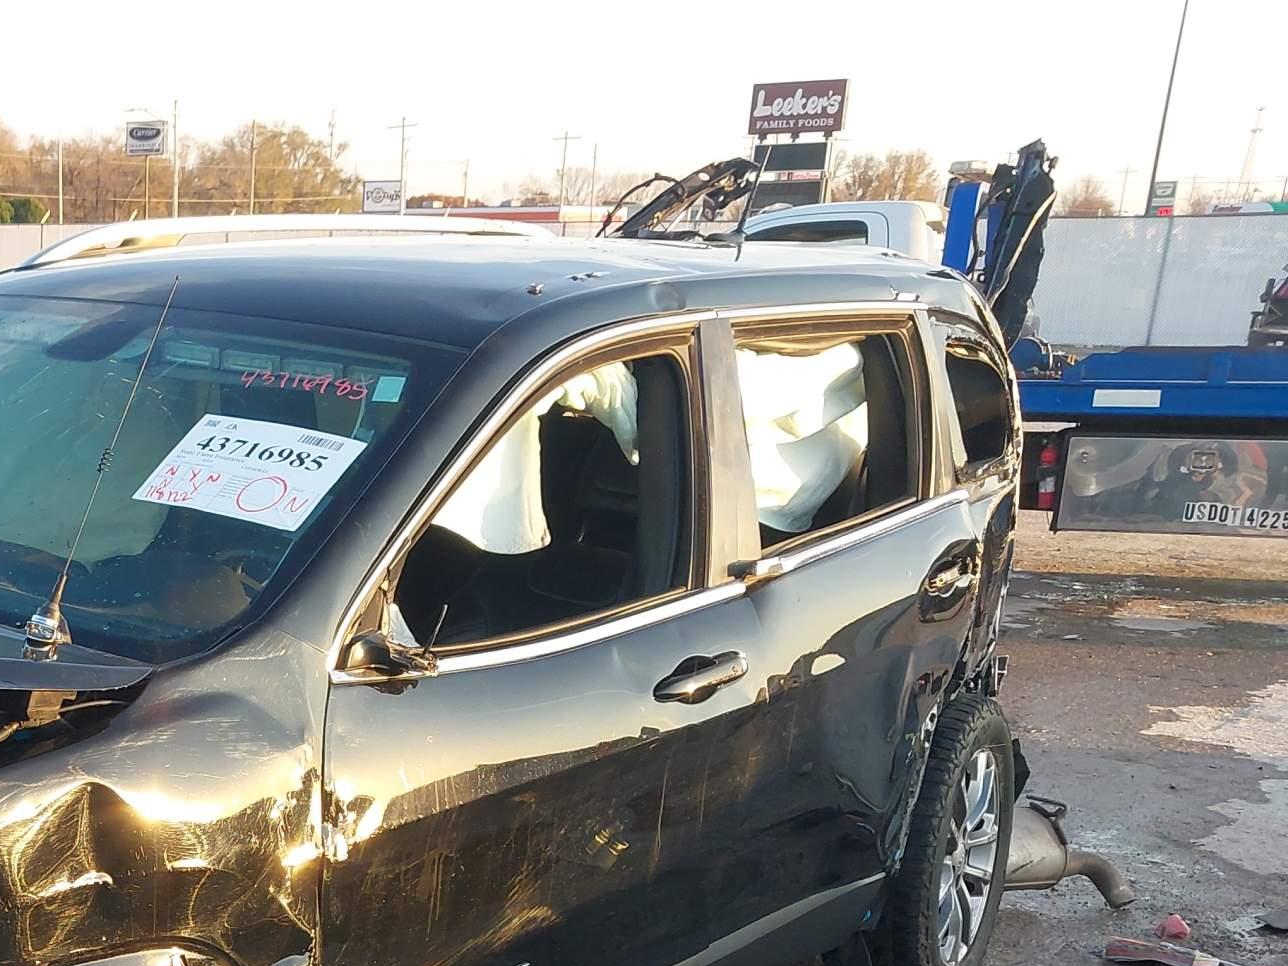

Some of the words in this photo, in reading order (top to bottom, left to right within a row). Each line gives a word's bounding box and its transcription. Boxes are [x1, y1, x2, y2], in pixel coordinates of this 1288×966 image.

[753, 89, 841, 117] Leeker's
[756, 119, 795, 129] FAMILY
[797, 118, 834, 128] FOODS
[240, 369, 375, 400] 43716985
[196, 434, 329, 472] 43716985
[1184, 503, 1241, 525] USDOT
